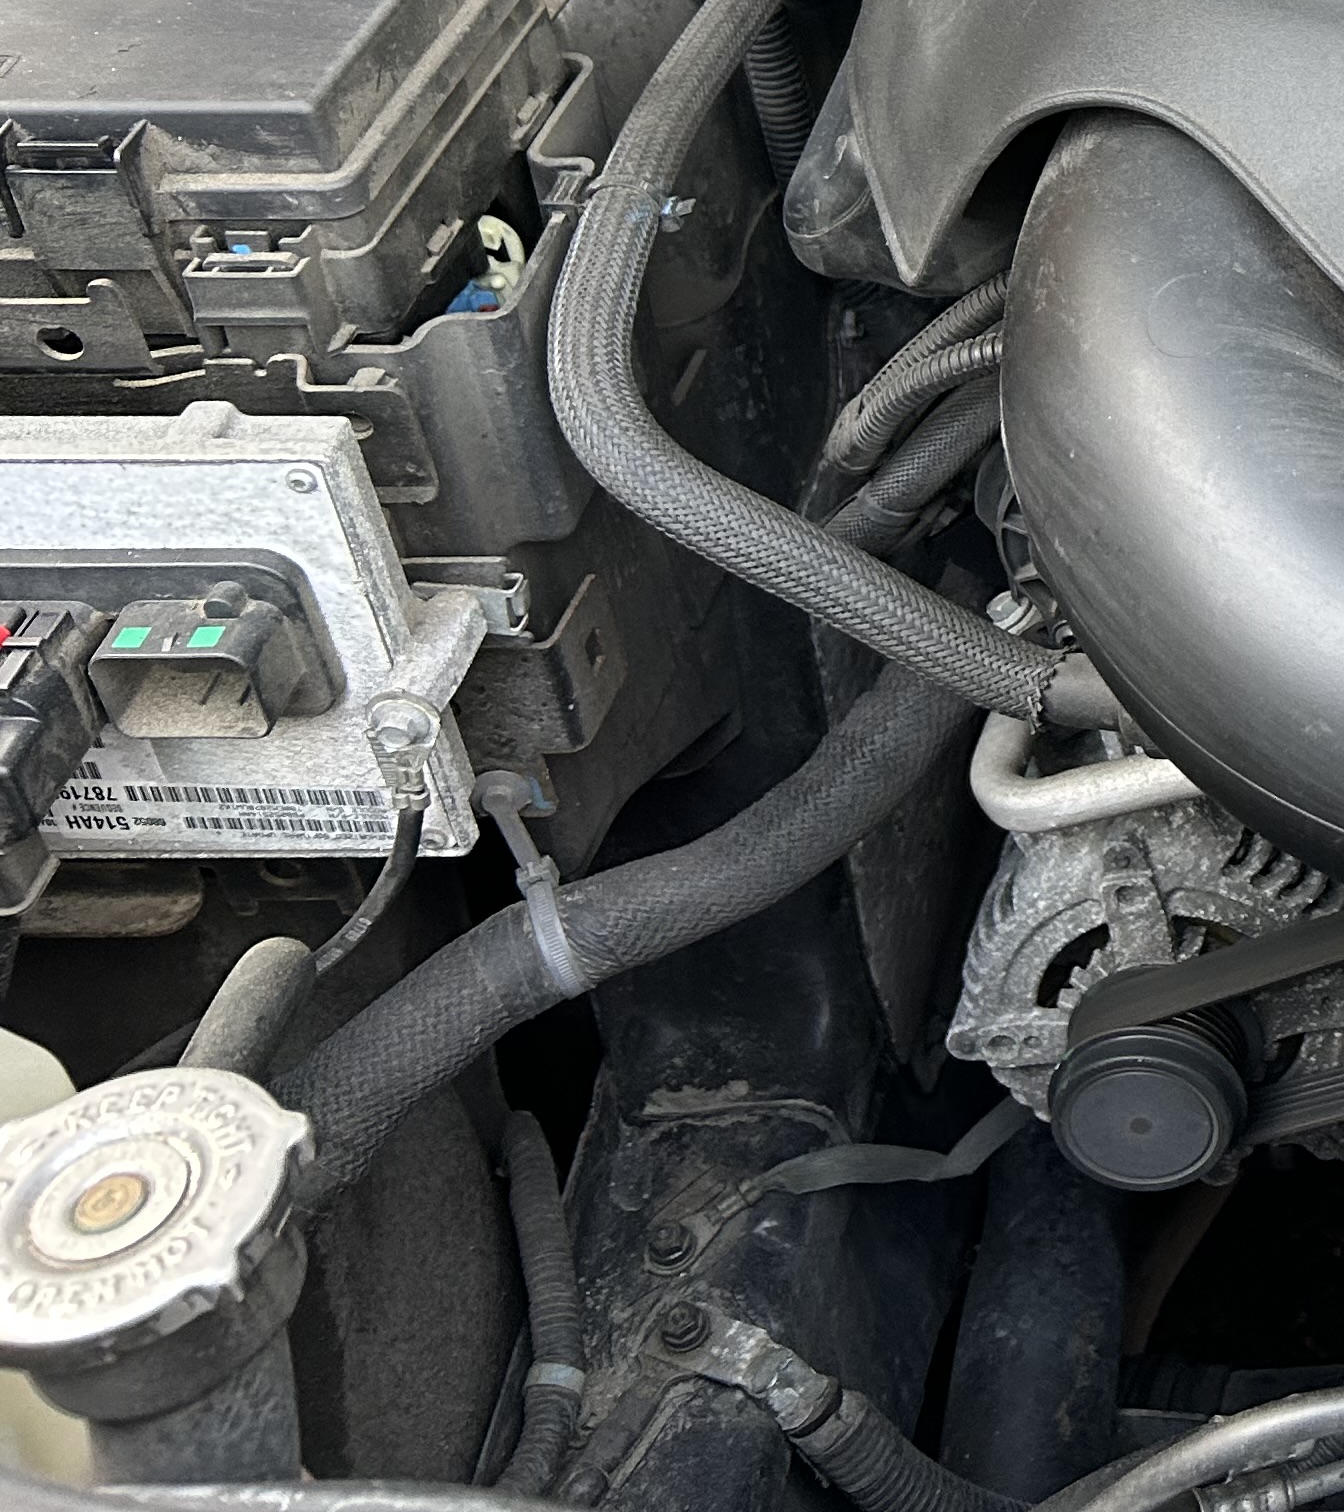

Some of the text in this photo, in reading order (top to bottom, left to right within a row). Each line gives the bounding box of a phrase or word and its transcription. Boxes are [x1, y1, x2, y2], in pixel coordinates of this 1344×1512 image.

[58, 786, 118, 802] 78719
[65, 815, 131, 830] 514AH
[60, 1081, 183, 1136] KEEP
